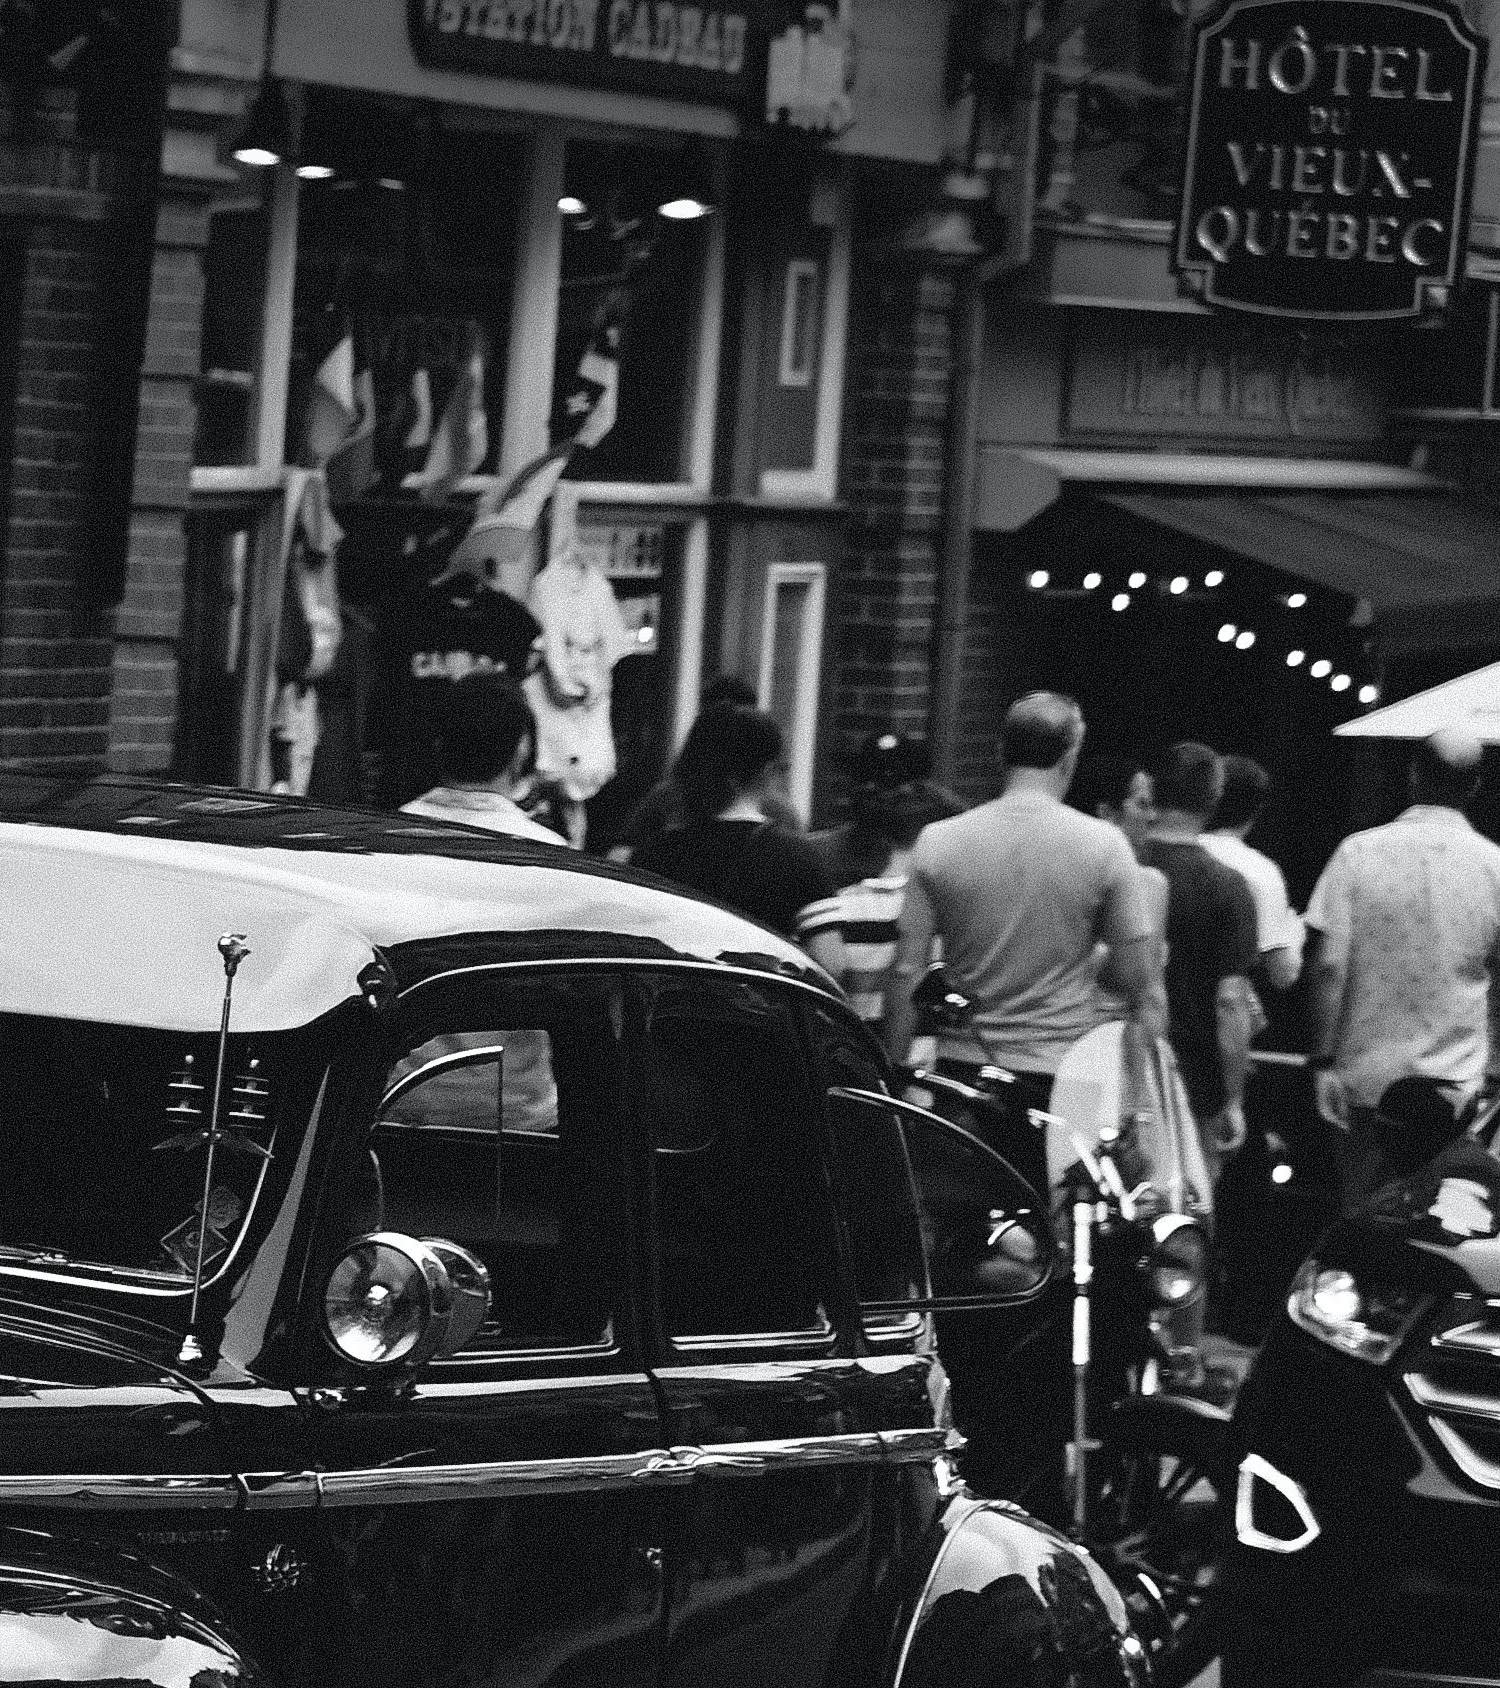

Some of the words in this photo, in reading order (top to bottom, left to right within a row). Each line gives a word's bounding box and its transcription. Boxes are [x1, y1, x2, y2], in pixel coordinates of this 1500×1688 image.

[1218, 24, 1454, 103] HÔTEL
[1308, 105, 1351, 135] DU
[1226, 141, 1434, 199] VIEUX-
[1195, 199, 1445, 267] QUÉBEC
